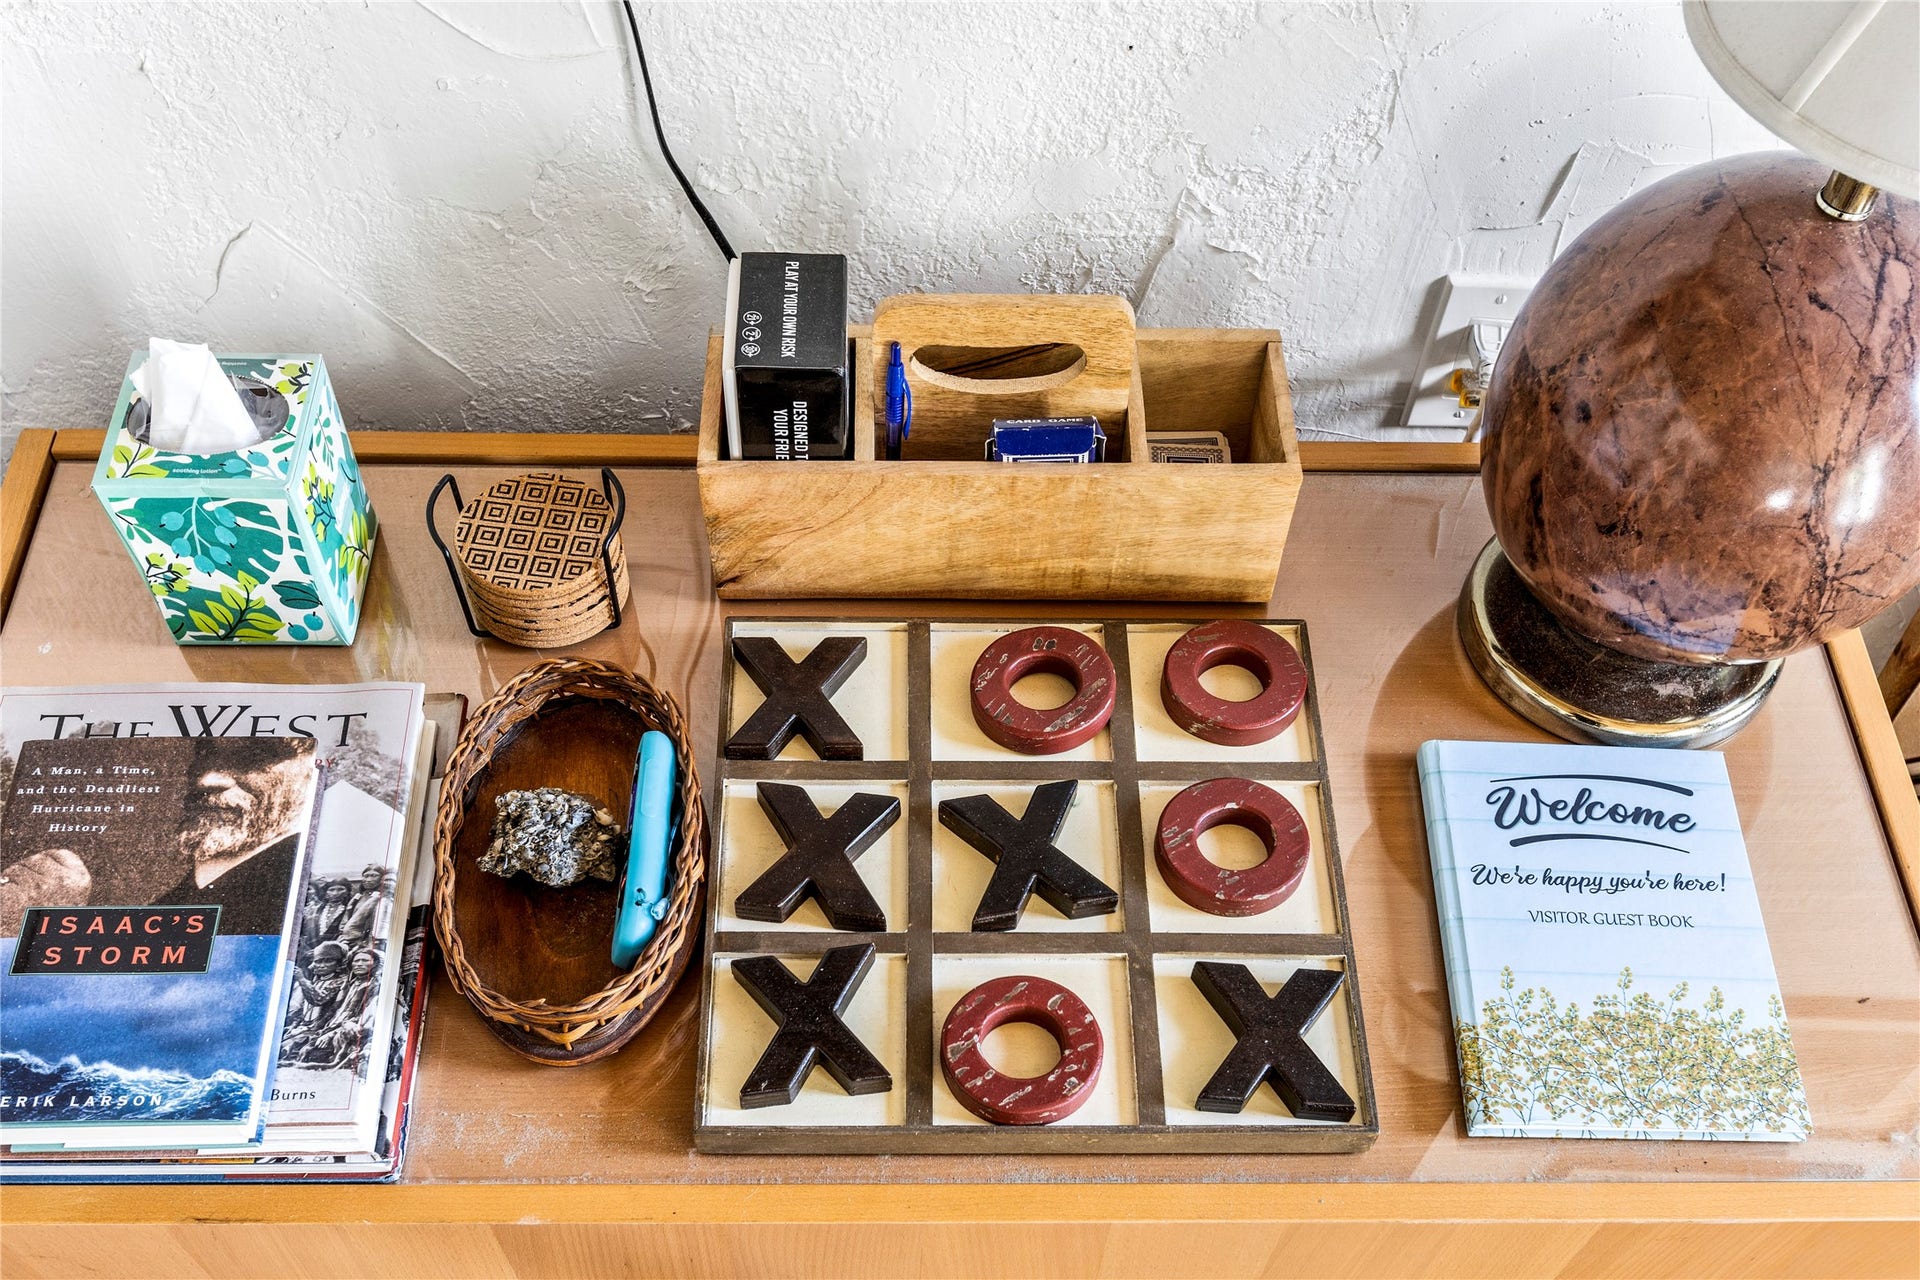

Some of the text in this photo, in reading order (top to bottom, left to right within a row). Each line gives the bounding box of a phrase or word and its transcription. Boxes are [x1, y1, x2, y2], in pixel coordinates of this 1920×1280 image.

[781, 261, 800, 358] PLAY AT YOUR OWN RISK
[773, 408, 790, 460] YOUR FRIE
[793, 401, 809, 461] DESIGNED T
[168, 704, 368, 748] WEST
[32, 767, 41, 776] A
[51, 767, 87, 776] Man,
[112, 766, 155, 775] Time,
[17, 784, 161, 795] and the Deadliest
[32, 804, 135, 814] Hurricane in
[1486, 786, 1697, 833] Welcome
[48, 824, 108, 834] History
[1470, 863, 1726, 895] We're happy you're here!
[39, 915, 205, 935] ISAAC'S
[1528, 910, 1695, 928] VISITOR GUEST BOOK
[42, 946, 187, 965] STORM
[0, 1095, 162, 1108] ERIK LARSON
[270, 1088, 316, 1101] Burns
